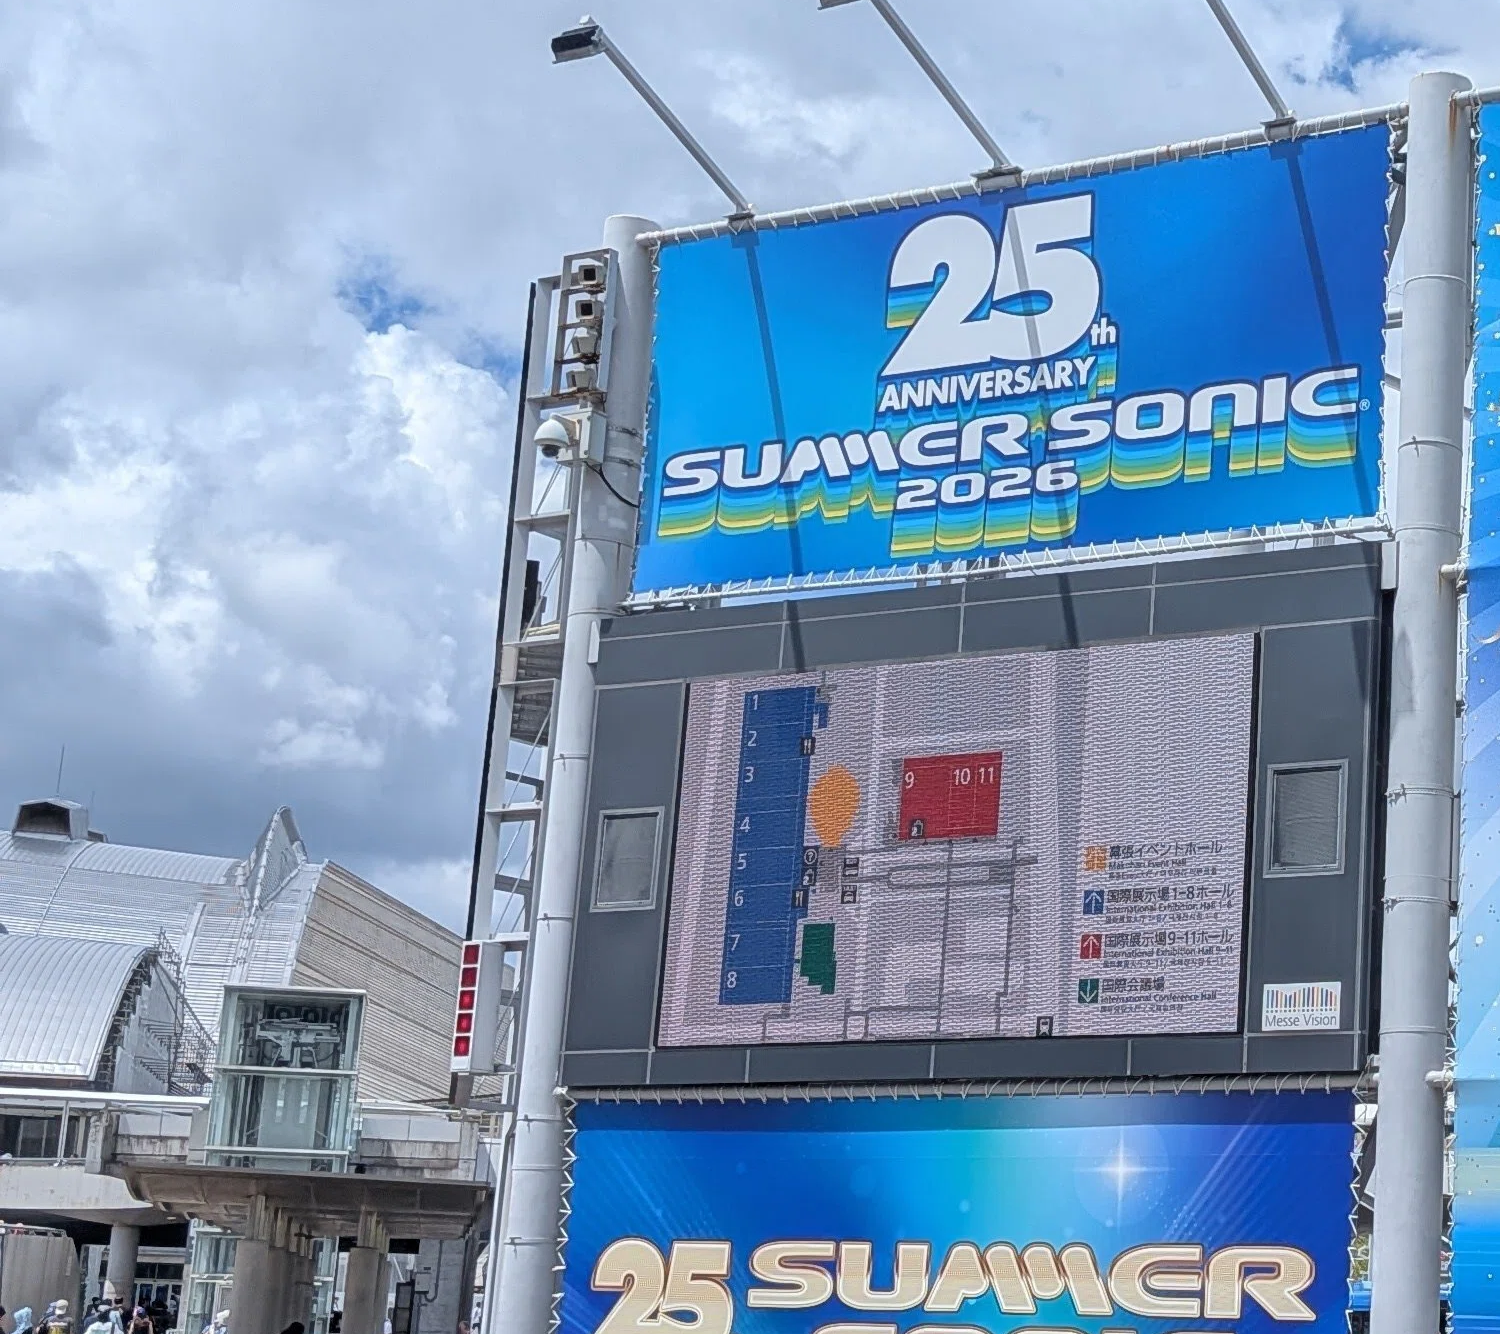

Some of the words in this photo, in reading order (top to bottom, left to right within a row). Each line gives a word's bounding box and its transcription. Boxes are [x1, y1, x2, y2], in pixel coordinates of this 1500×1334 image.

[878, 356, 1096, 413] ANNIVERSARY
[663, 413, 1046, 498] SUMMER
[1045, 366, 1361, 450] SONIC
[897, 459, 1079, 510] 2026
[752, 694, 760, 710] 1
[747, 730, 757, 747] 2
[744, 766, 754, 783] 3
[905, 771, 915, 789] 9
[953, 768, 971, 785] 10
[979, 767, 994, 784] 11
[740, 816, 751, 832] 4
[737, 853, 747, 870] 5
[734, 889, 744, 907] 6
[729, 933, 740, 952] 7
[726, 971, 737, 988] 8
[1265, 1014, 1300, 1027] Messe
[1303, 1013, 1337, 1026] Vision
[746, 1240, 1317, 1323] SUMMER
